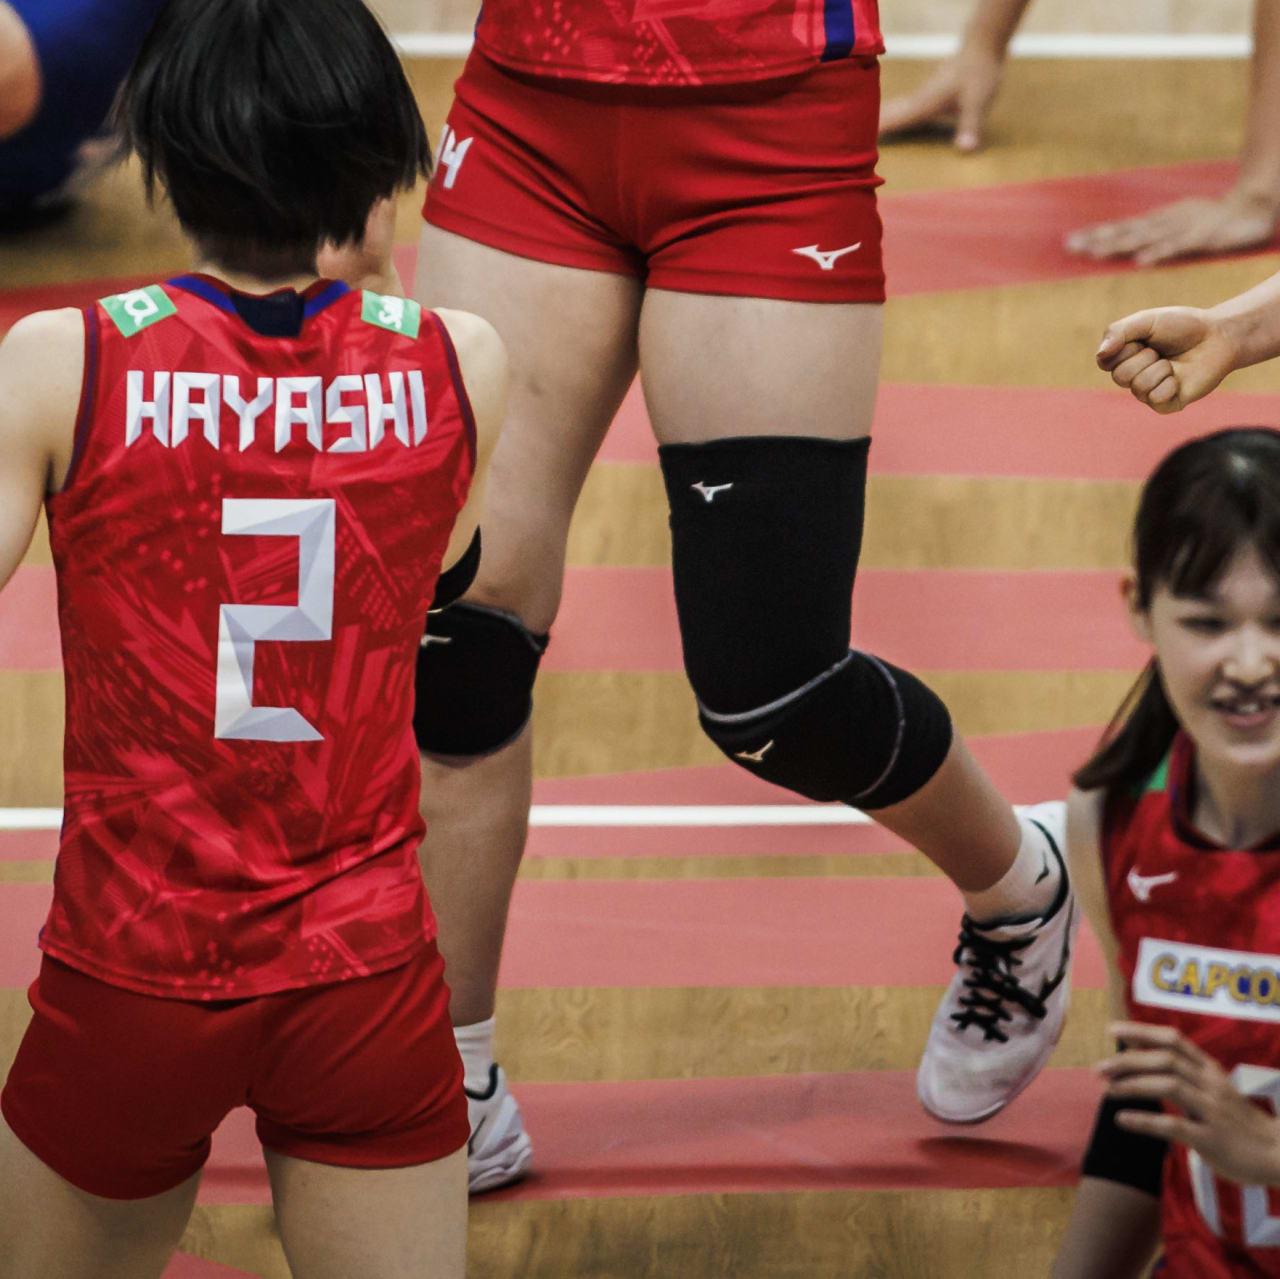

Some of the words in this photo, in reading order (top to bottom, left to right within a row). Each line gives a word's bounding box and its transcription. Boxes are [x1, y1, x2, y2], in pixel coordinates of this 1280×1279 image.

[431, 122, 475, 190] 4
[126, 369, 428, 454] HAYASHI
[214, 497, 336, 743] 2
